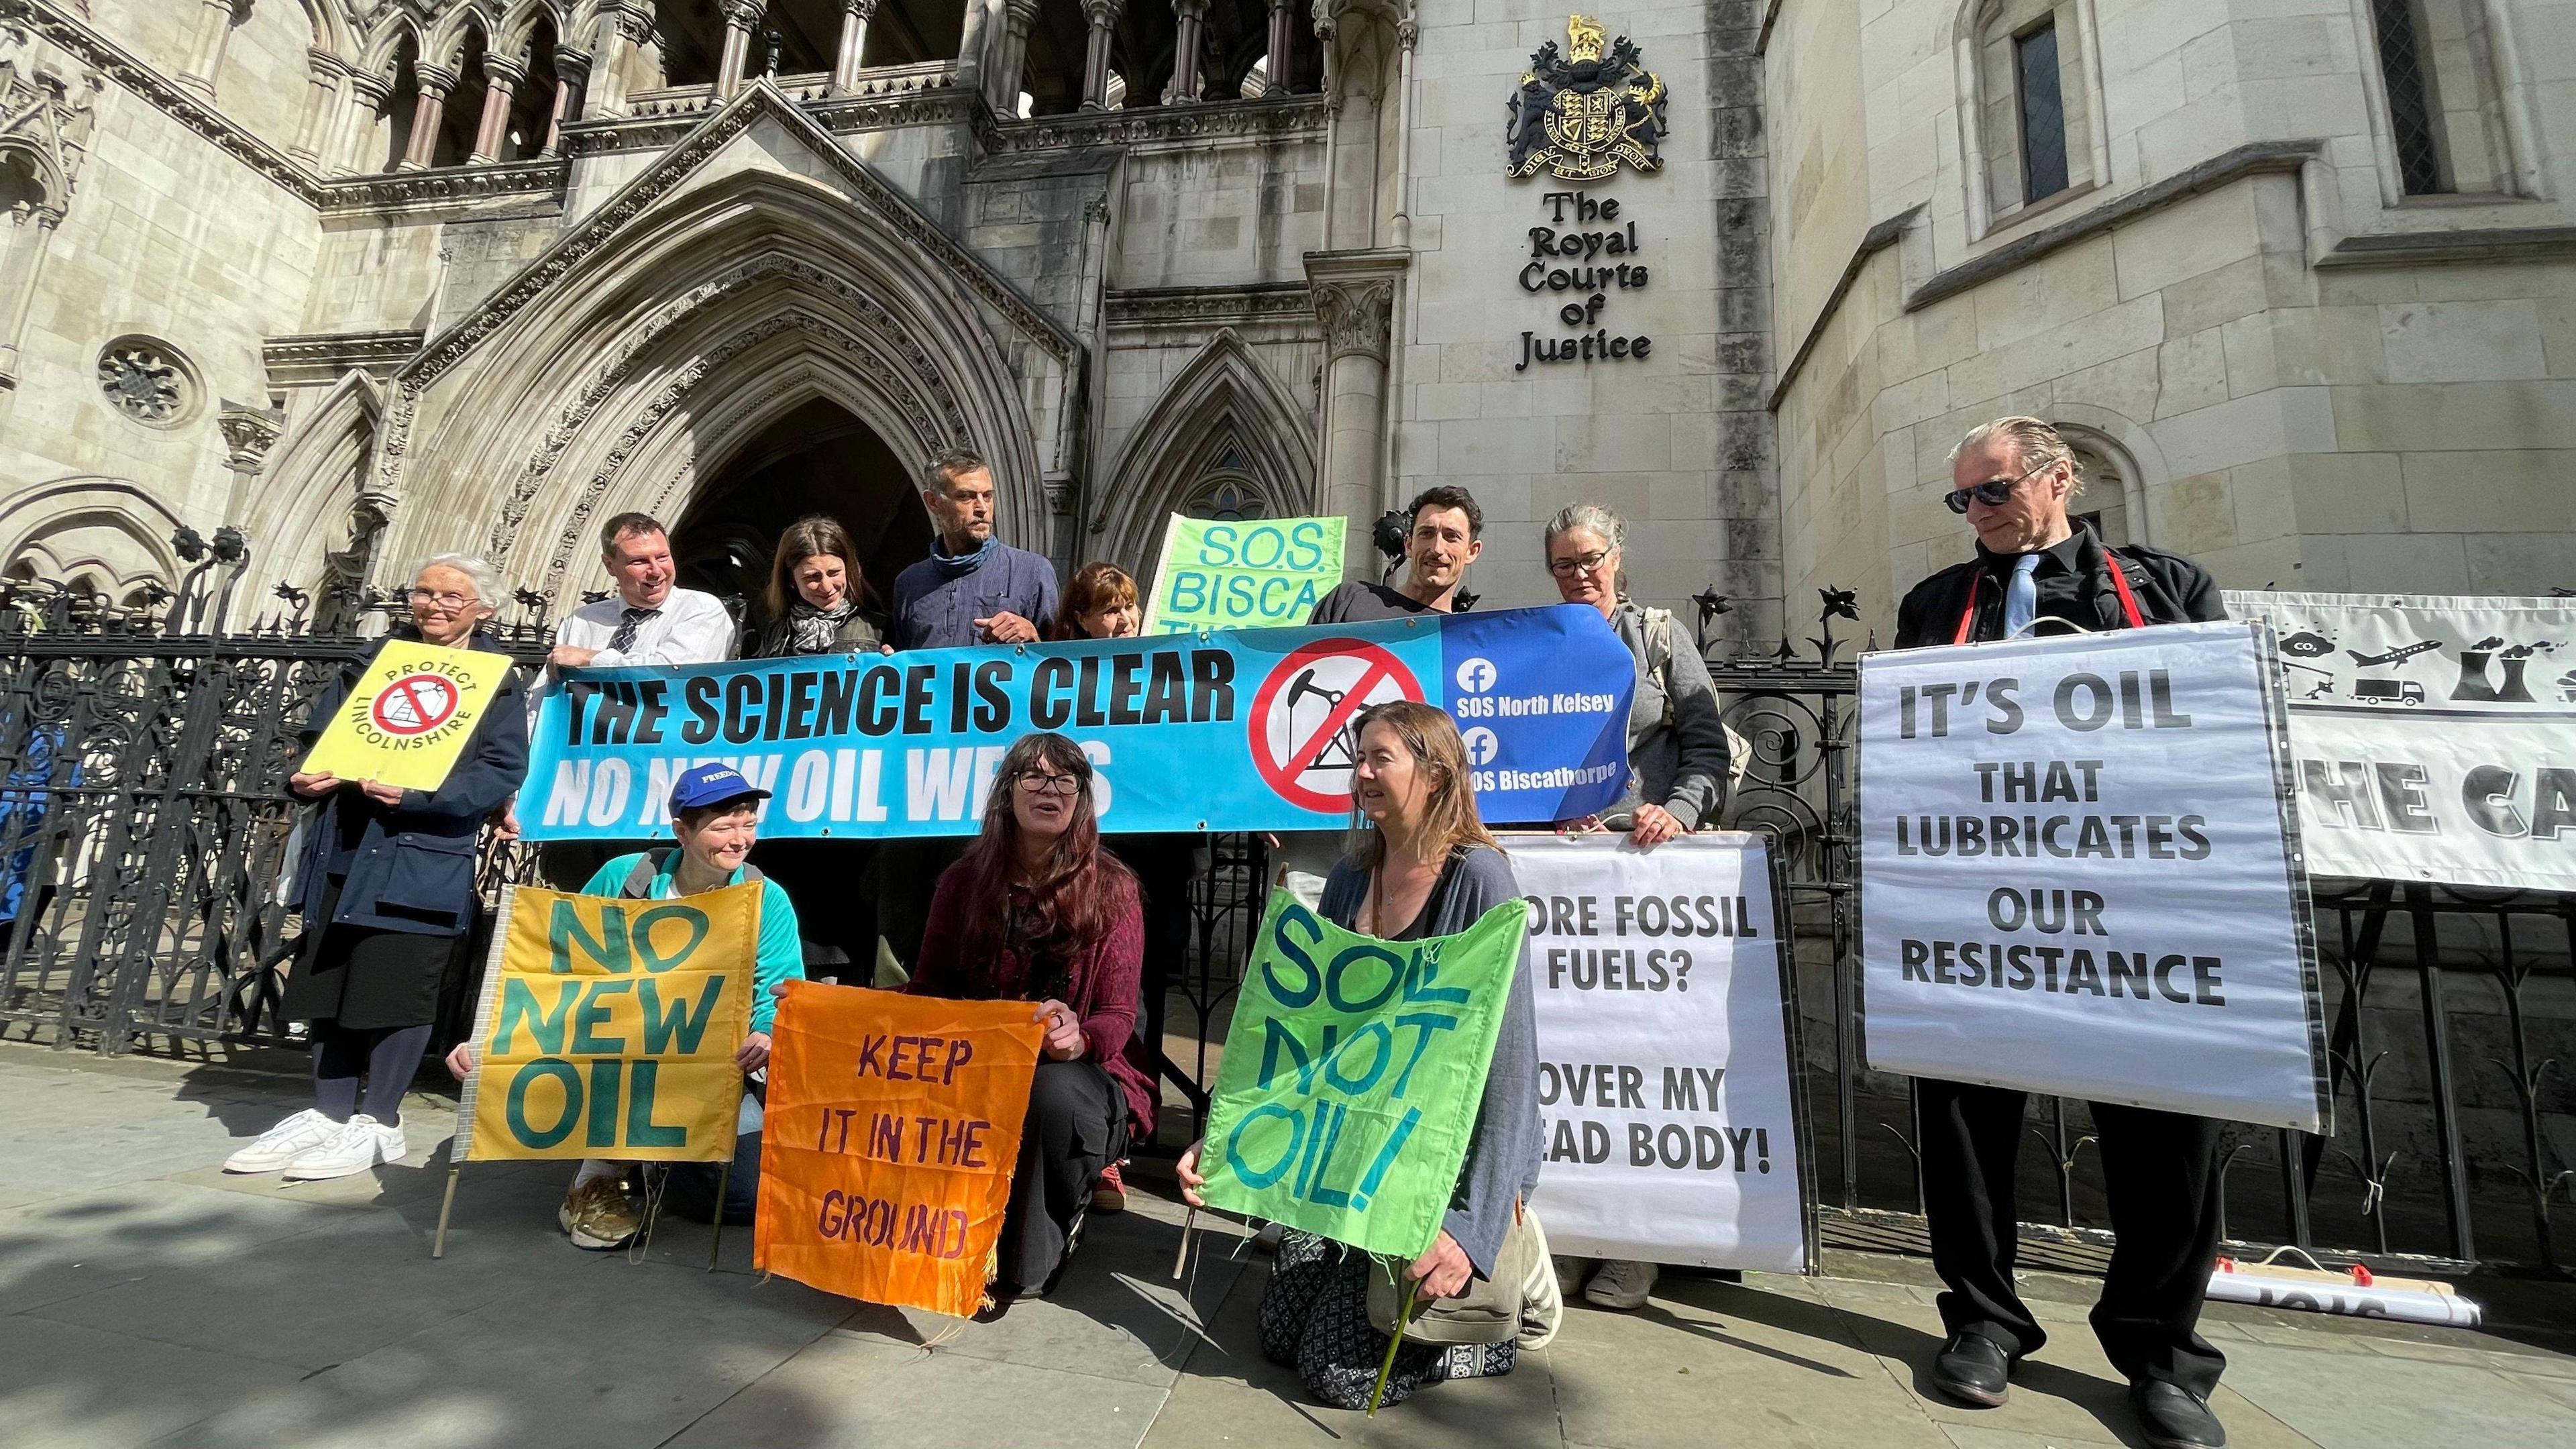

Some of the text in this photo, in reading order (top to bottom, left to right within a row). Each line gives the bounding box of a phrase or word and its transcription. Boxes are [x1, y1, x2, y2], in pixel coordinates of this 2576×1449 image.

[1612, 144, 1650, 169] DROIT
[1542, 191, 1620, 222] The
[1528, 220, 1639, 262] Royal
[1519, 260, 1648, 292] Courts
[1560, 292, 1606, 325] of
[1515, 328, 1652, 370] Justice
[1199, 522, 1326, 572] S.O.S.
[1169, 572, 1317, 620] BISCA
[384, 661, 477, 691] PROTECT
[564, 649, 1236, 746] THE SCIENCE IS CLEAR
[352, 696, 472, 751] LINCOLNSHIRE
[1456, 692, 1614, 718] SOS North Kelsey
[1899, 668, 2192, 739] IT'S OIL
[542, 741, 1112, 826] NO NW OIL WES
[1472, 761, 1617, 792] OS Biscathorpe
[1973, 759, 2104, 803] THAT
[2296, 759, 2440, 836] HE
[1896, 814, 2212, 861] LUBRICATES
[1524, 895, 1758, 938] ORE FOSSIL
[1986, 886, 2109, 936] OUR
[549, 900, 710, 974] NO
[1548, 948, 1693, 992] FUELS?
[1900, 938, 2226, 1006] RESISTANCE
[490, 975, 726, 1055] NEW
[857, 1033, 973, 1086] KEEP
[1256, 1012, 1458, 1099] NOT
[506, 1057, 687, 1150] OIL
[1538, 1061, 1726, 1112] OVER MY
[818, 1107, 991, 1168] IT IN THE
[1226, 1098, 1424, 1214] OIL!
[1627, 1122, 1771, 1175] BODY!
[818, 1188, 969, 1259] GROUND
